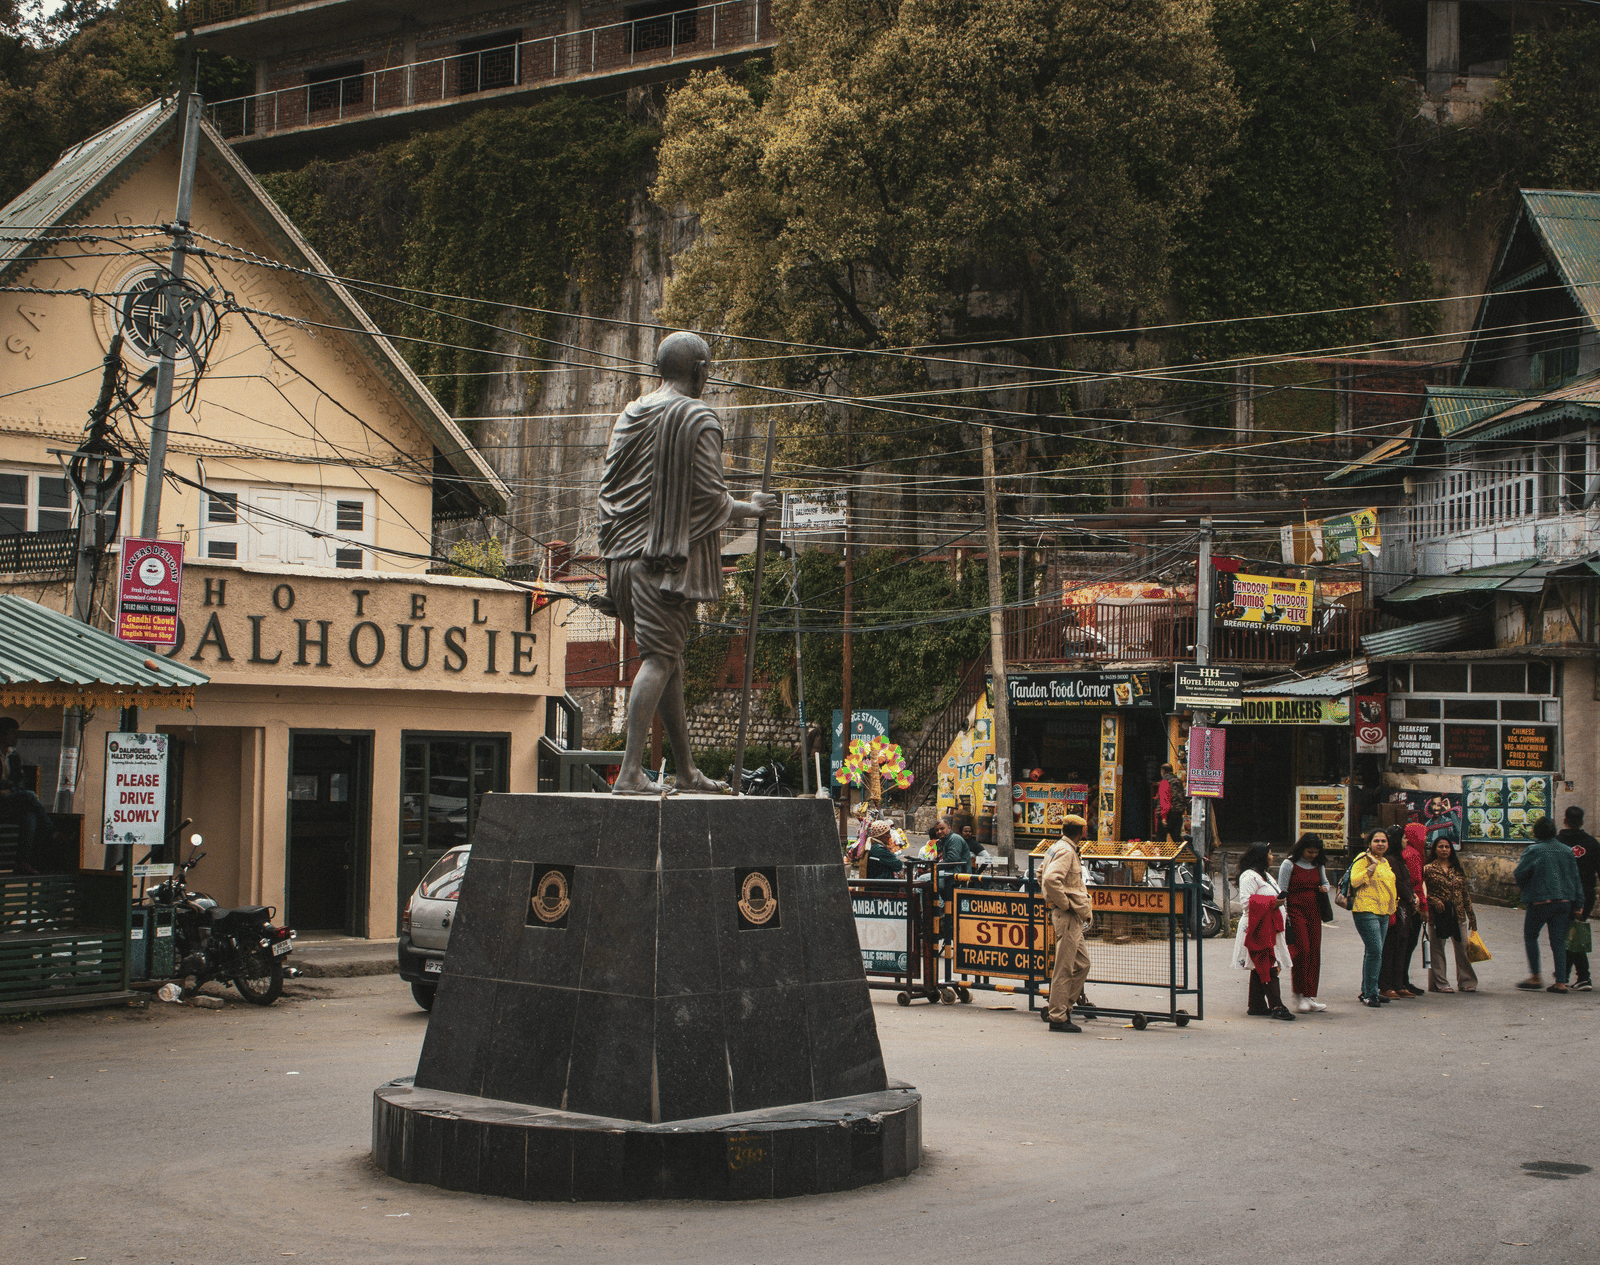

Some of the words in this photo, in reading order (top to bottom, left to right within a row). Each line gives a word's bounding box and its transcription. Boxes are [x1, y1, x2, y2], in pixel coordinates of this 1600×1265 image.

[124, 545, 152, 581] BAKERS
[152, 545, 178, 584] DELIGHT
[1233, 580, 1269, 595] TANDOORI
[204, 577, 488, 624] HOTEL
[1272, 594, 1308, 608] TANDOORI
[127, 615, 151, 624] Gandhi
[152, 616, 175, 625] Chowk
[1286, 608, 1307, 622] चाय
[1223, 620, 1262, 629] BREAKFAST
[1266, 624, 1301, 632] FASTFOOD
[1199, 668, 1220, 677] HH
[1180, 677, 1203, 686] HOTEL
[1204, 678, 1240, 687] HIGHLAND
[1010, 681, 1048, 698] Tandon
[1049, 680, 1074, 698] Food
[1076, 680, 1111, 698] Corner
[1275, 701, 1322, 719] BAKERS
[862, 712, 886, 735] STATION
[1398, 725, 1429, 733] BREAKFAST
[1398, 734, 1417, 742] CHANA
[1511, 728, 1536, 736] CHINESE
[1400, 749, 1432, 757] SANDWICHES
[1527, 752, 1539, 760] RICE
[1506, 759, 1525, 767] CHEESE
[1526, 760, 1543, 768] CHILLY
[957, 762, 983, 781] TFC
[1191, 769, 1222, 777] DELIGHT
[116, 774, 159, 787] PLEASE
[120, 792, 155, 804] DRIVE
[113, 810, 159, 823] SLOWLY
[1119, 893, 1164, 908] POLICE
[852, 901, 875, 915] AMBA
[877, 901, 907, 916] POLICE
[970, 900, 1008, 915] CHAMBA
[1011, 901, 1044, 917] POLCE
[875, 952, 896, 962] SCHOOL
[963, 949, 1008, 967] TRAFFIC
[426, 962, 433, 970] HP
